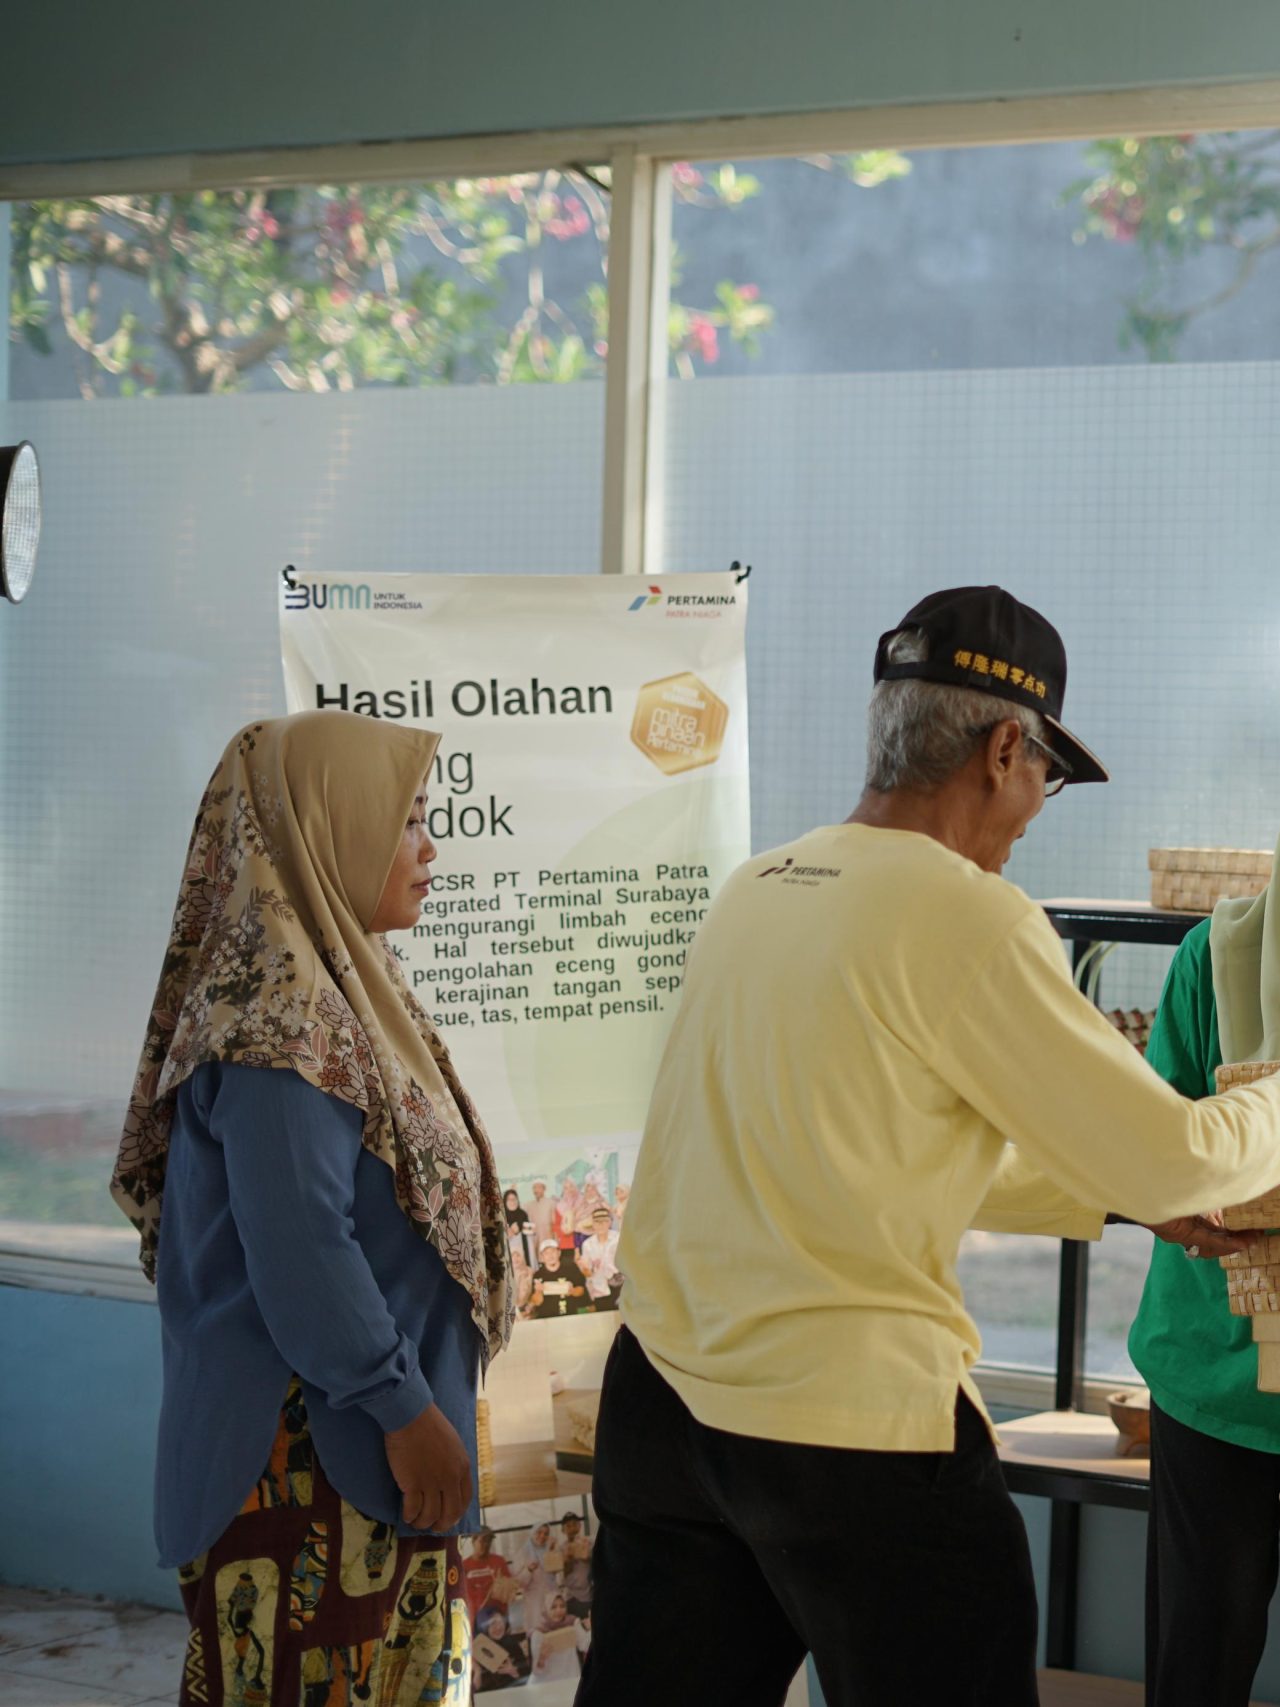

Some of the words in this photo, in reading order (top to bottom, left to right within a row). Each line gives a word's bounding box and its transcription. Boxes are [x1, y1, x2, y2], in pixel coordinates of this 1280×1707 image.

[667, 595, 736, 606] PERTAMINA
[316, 680, 433, 719] Hasil
[451, 678, 613, 717] Olahan
[430, 874, 475, 892] CSR
[494, 871, 520, 888] PT
[538, 866, 640, 886] Pertamina
[656, 864, 709, 880] Patra
[790, 866, 842, 877] PERTAMINA
[514, 889, 602, 910] Terminal
[616, 885, 711, 905] Surabaya
[413, 914, 535, 939] mengurangi
[560, 910, 627, 929] limbah
[434, 941, 467, 959] Hal
[491, 935, 575, 956] tersebut
[413, 961, 533, 987] pengolahan
[555, 957, 616, 975] eceng
[435, 984, 529, 1006] kerajinan
[553, 978, 622, 998] tangan
[481, 1007, 519, 1024] tas,
[524, 1001, 593, 1022] tempat
[600, 995, 665, 1019] pensil.
